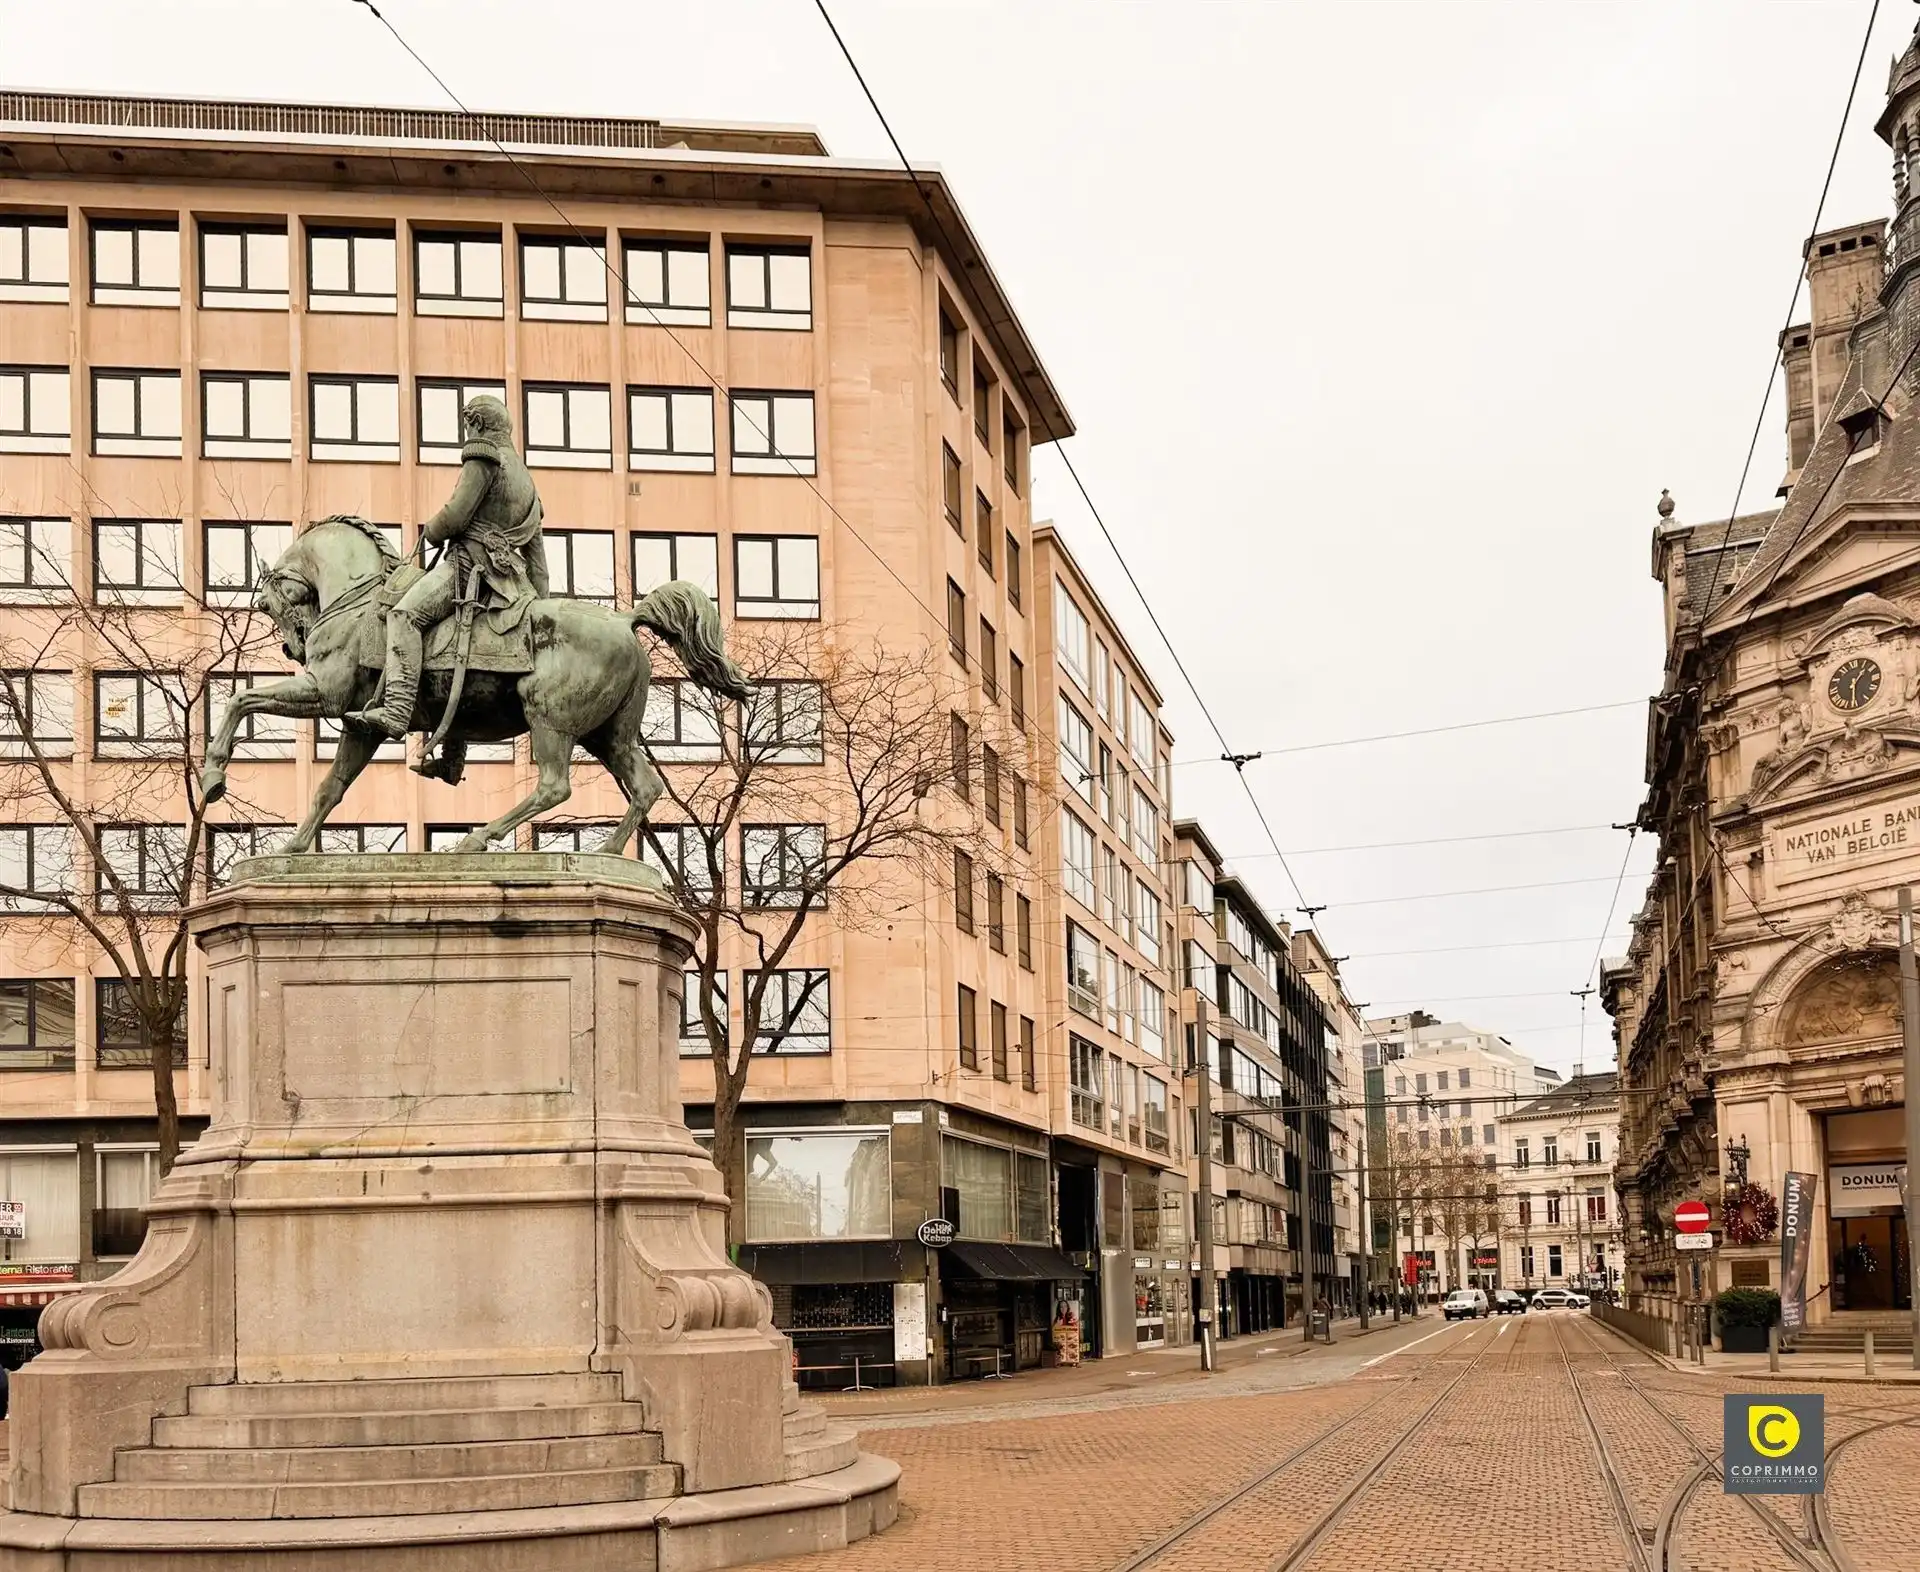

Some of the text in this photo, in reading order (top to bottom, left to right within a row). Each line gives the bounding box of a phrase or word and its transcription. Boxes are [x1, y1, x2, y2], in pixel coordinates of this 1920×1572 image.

[1786, 819, 1872, 851] NATIONALE
[1807, 827, 1907, 863] VAN BELGIË
[1842, 1174, 1898, 1185] DONUM
[1786, 1179, 1801, 1236] DONUM
[923, 1234, 952, 1244] Kebap
[26, 1264, 73, 1274] Ristorante
